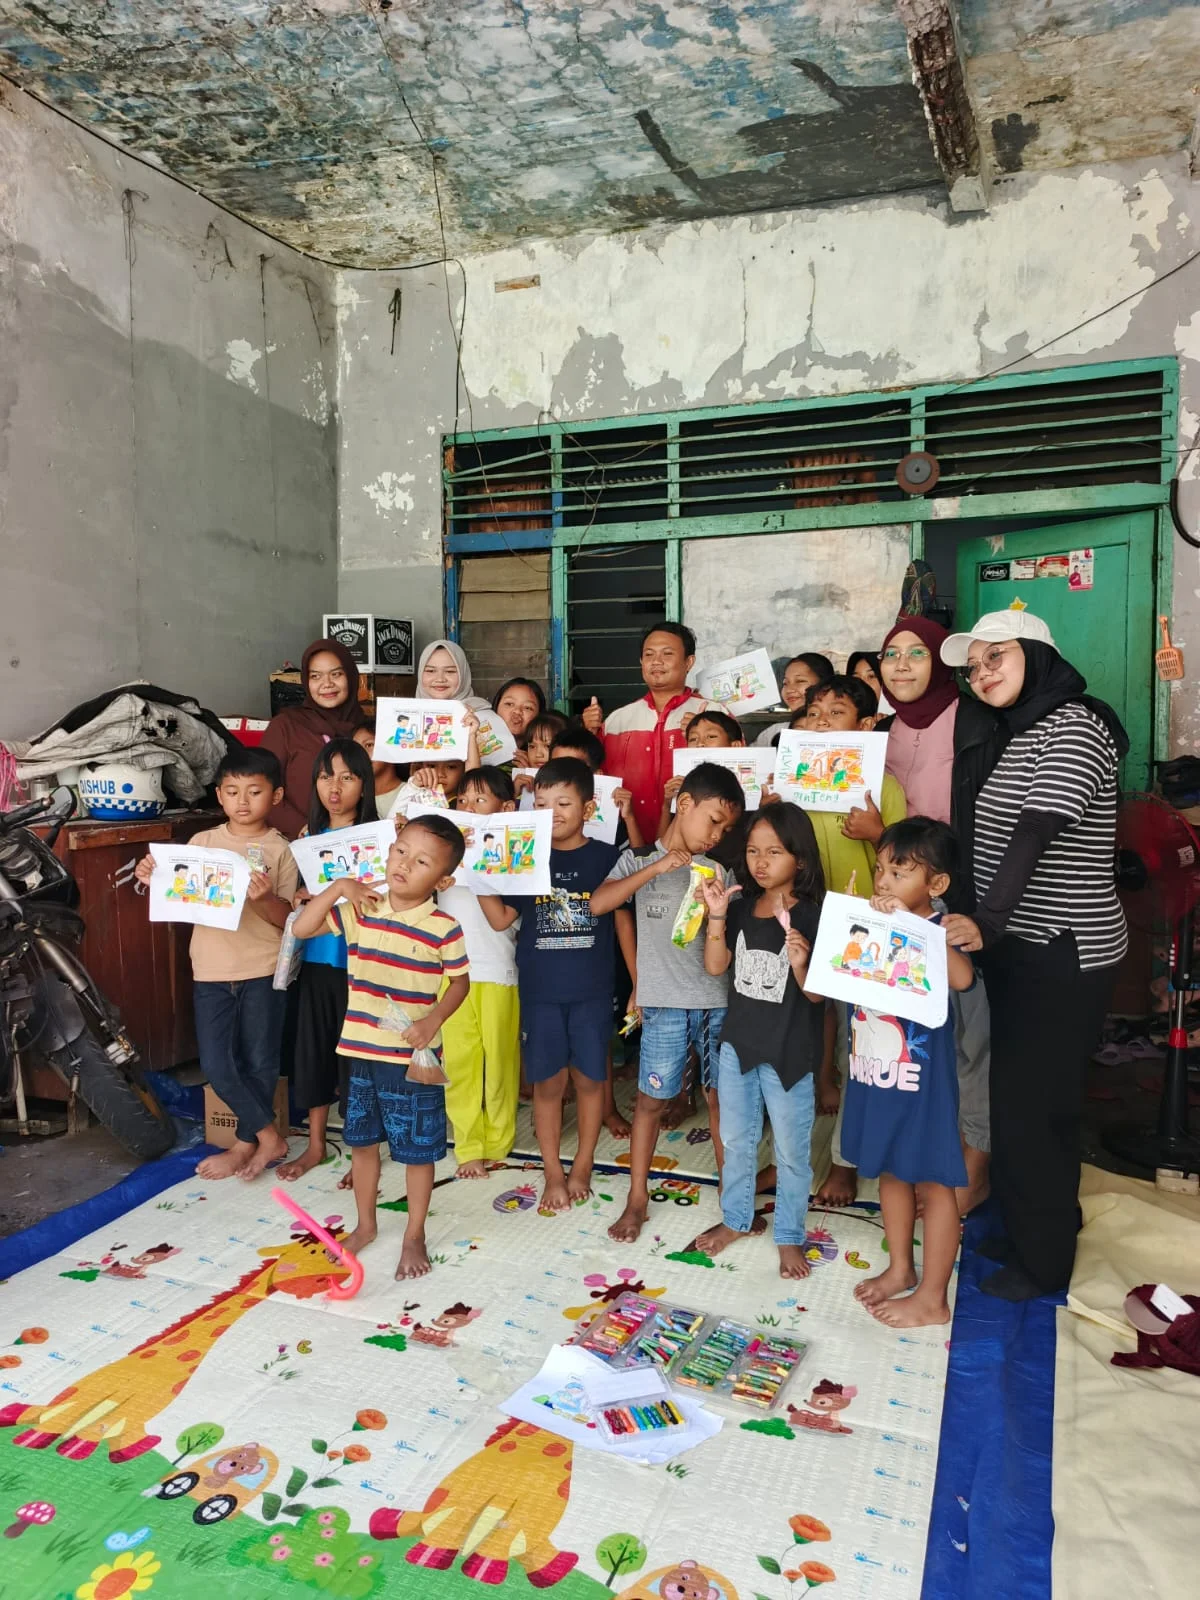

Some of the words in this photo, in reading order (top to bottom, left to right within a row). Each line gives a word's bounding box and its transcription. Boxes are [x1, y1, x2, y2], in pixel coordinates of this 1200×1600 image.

[330, 623, 344, 637] JACK
[377, 628, 391, 646] JACK
[80, 780, 116, 795] DISHUB
